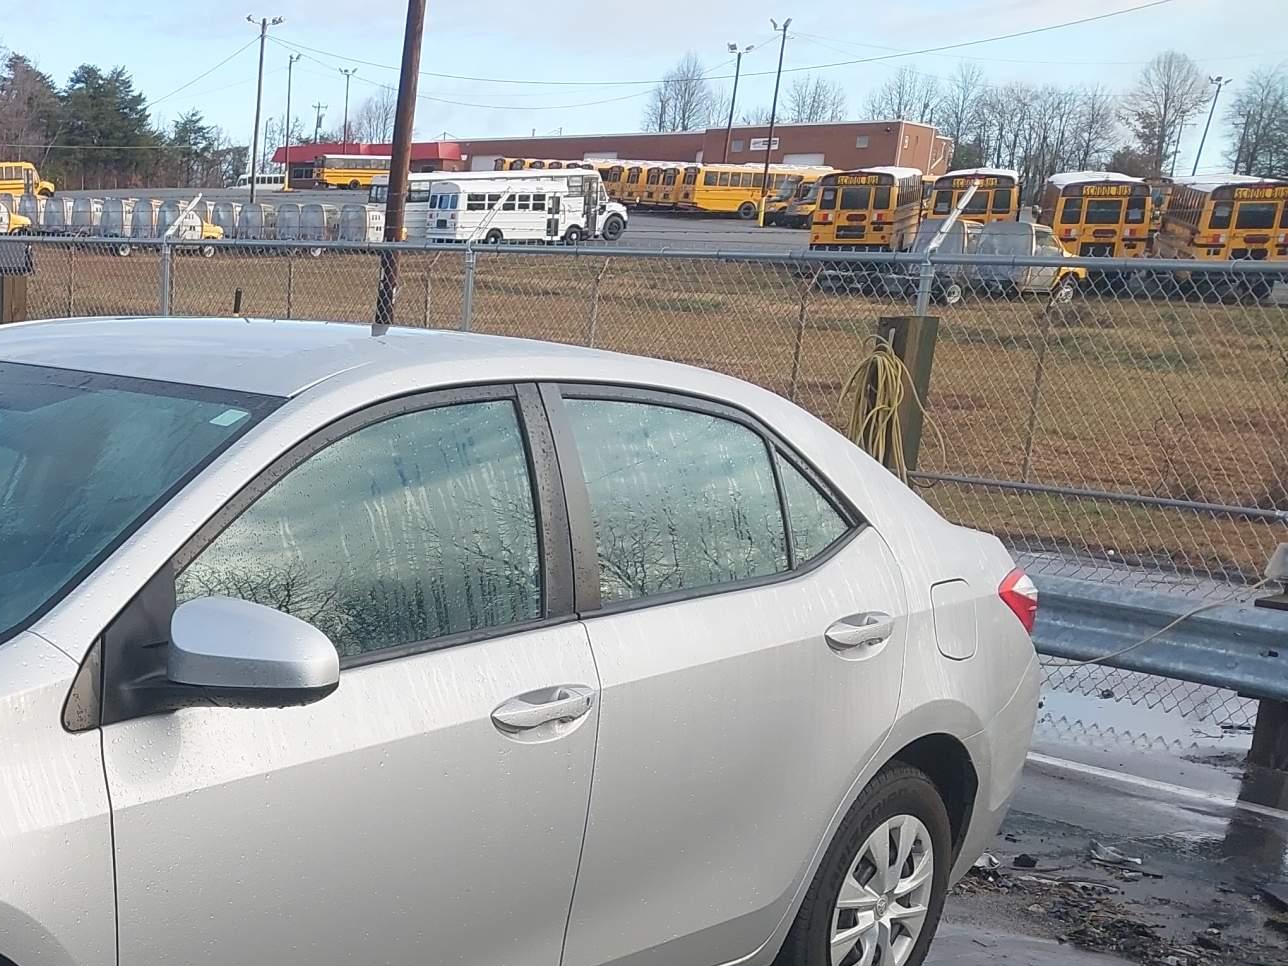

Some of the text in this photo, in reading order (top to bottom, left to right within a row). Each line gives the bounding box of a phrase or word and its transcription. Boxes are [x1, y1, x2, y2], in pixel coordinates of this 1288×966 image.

[1083, 185, 1131, 195] SCHOOL BUS
[1235, 188, 1266, 200] SCHOOL
